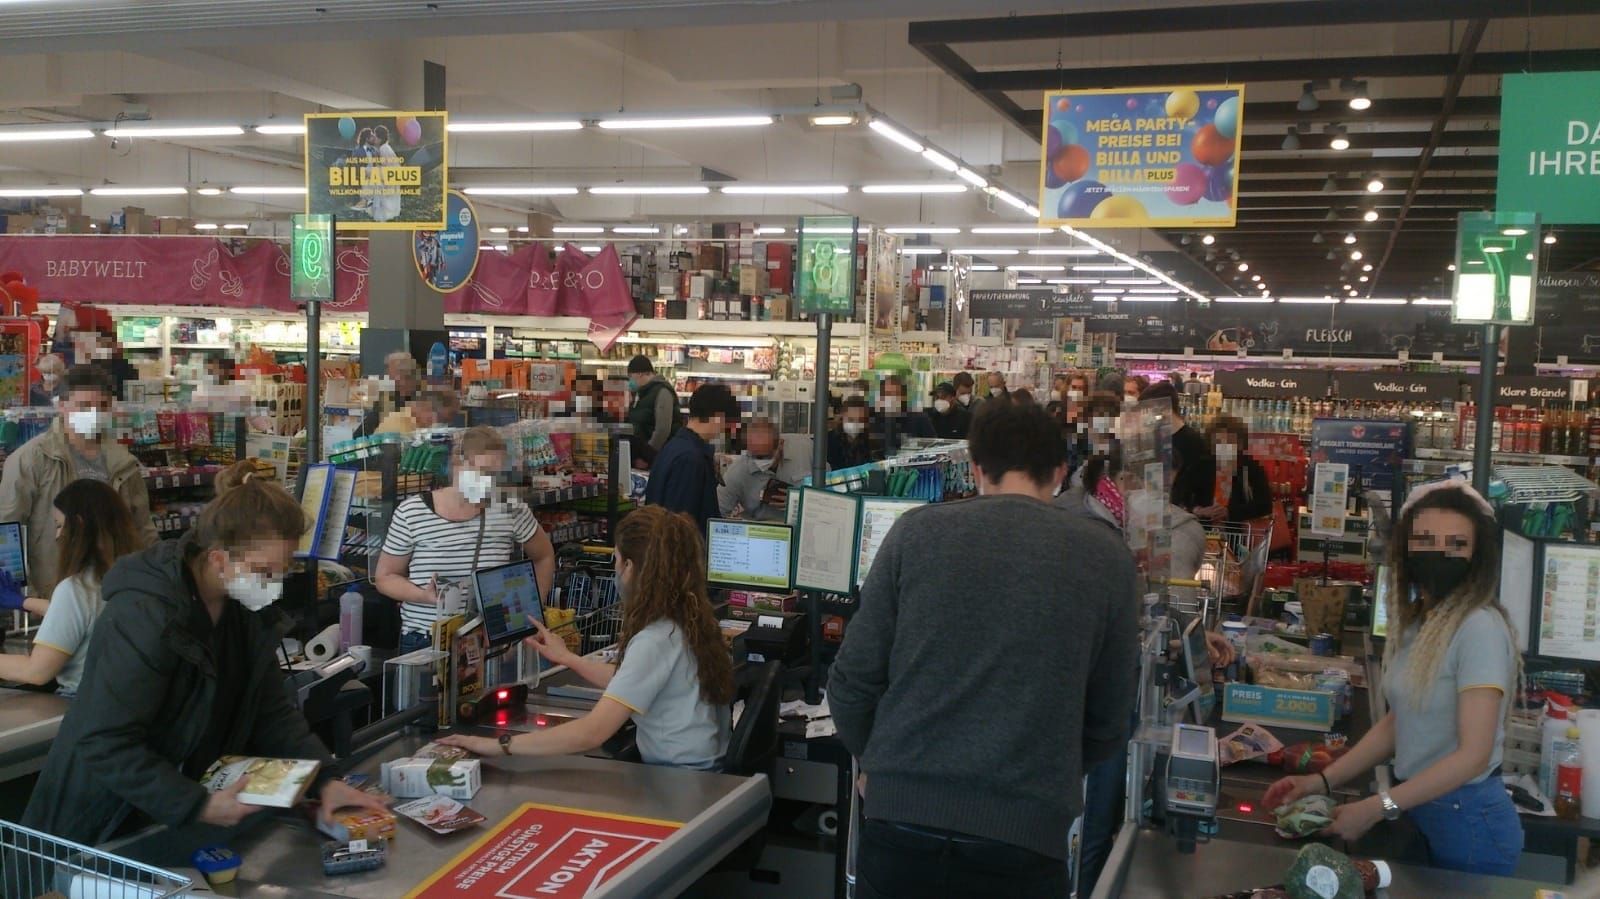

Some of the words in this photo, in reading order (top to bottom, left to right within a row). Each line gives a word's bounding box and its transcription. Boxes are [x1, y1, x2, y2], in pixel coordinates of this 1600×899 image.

[1086, 119, 1131, 132] MEGA
[1136, 118, 1196, 131] PARTY-
[1098, 134, 1152, 148] PREISE
[1156, 134, 1181, 146] BEI
[1096, 152, 1140, 166] BILLA
[1146, 152, 1180, 164] UND
[329, 167, 381, 186] BILLA
[387, 170, 417, 182] PLUS
[1098, 169, 1140, 182] BILLA
[1147, 171, 1174, 180] PLUS
[46, 260, 147, 278] BABYWELT
[1479, 236, 1517, 297] 7
[1246, 378, 1275, 388] Vodka
[1280, 379, 1297, 388] Gin
[1374, 382, 1404, 393] Vodka
[1409, 383, 1426, 393] Gin
[1500, 386, 1527, 397] Klare
[1530, 387, 1567, 398] Brände
[1232, 690, 1262, 700] PREIS
[490, 824, 544, 863] GÜNSTIGE
[494, 842, 541, 874] EXTREM
[536, 838, 609, 894] AKTION
[455, 862, 499, 890] PREISE
